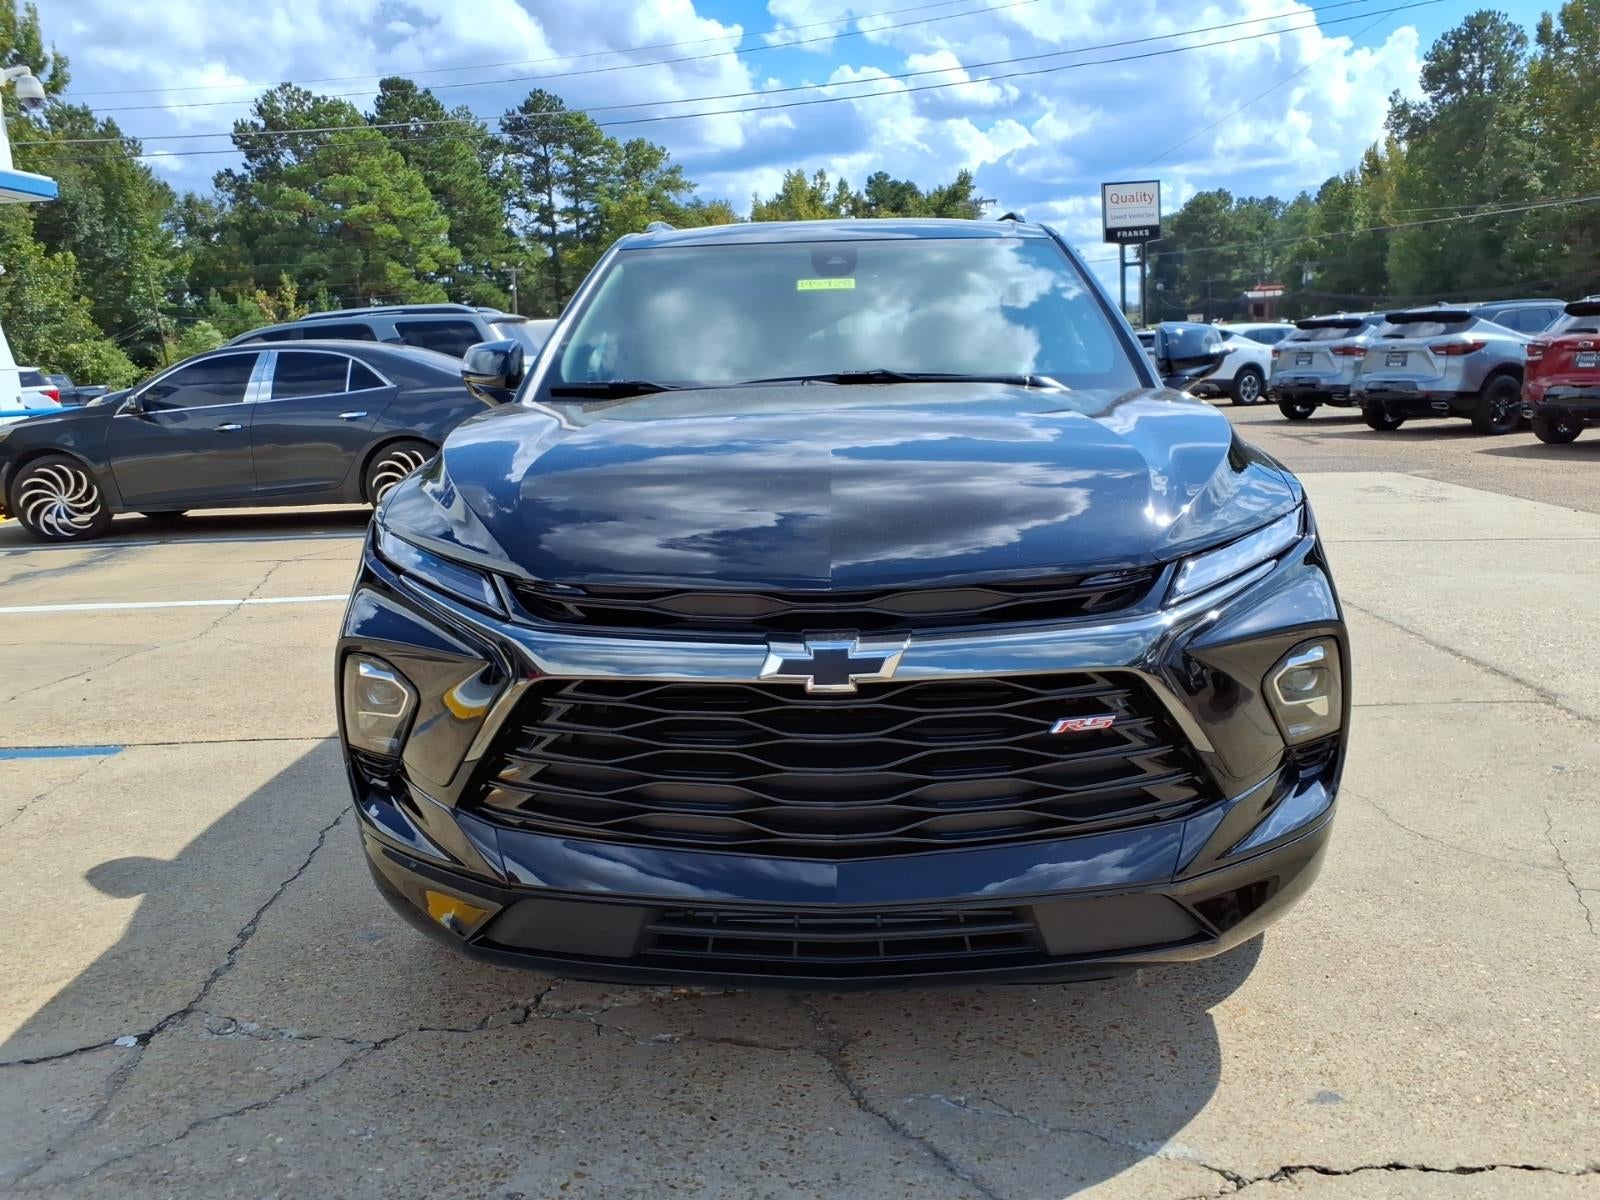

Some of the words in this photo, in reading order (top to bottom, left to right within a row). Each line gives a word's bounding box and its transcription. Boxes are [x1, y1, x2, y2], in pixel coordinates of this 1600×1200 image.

[1110, 192, 1154, 204] Quality
[1117, 229, 1150, 238] FRANKS
[1051, 716, 1116, 733] RS
